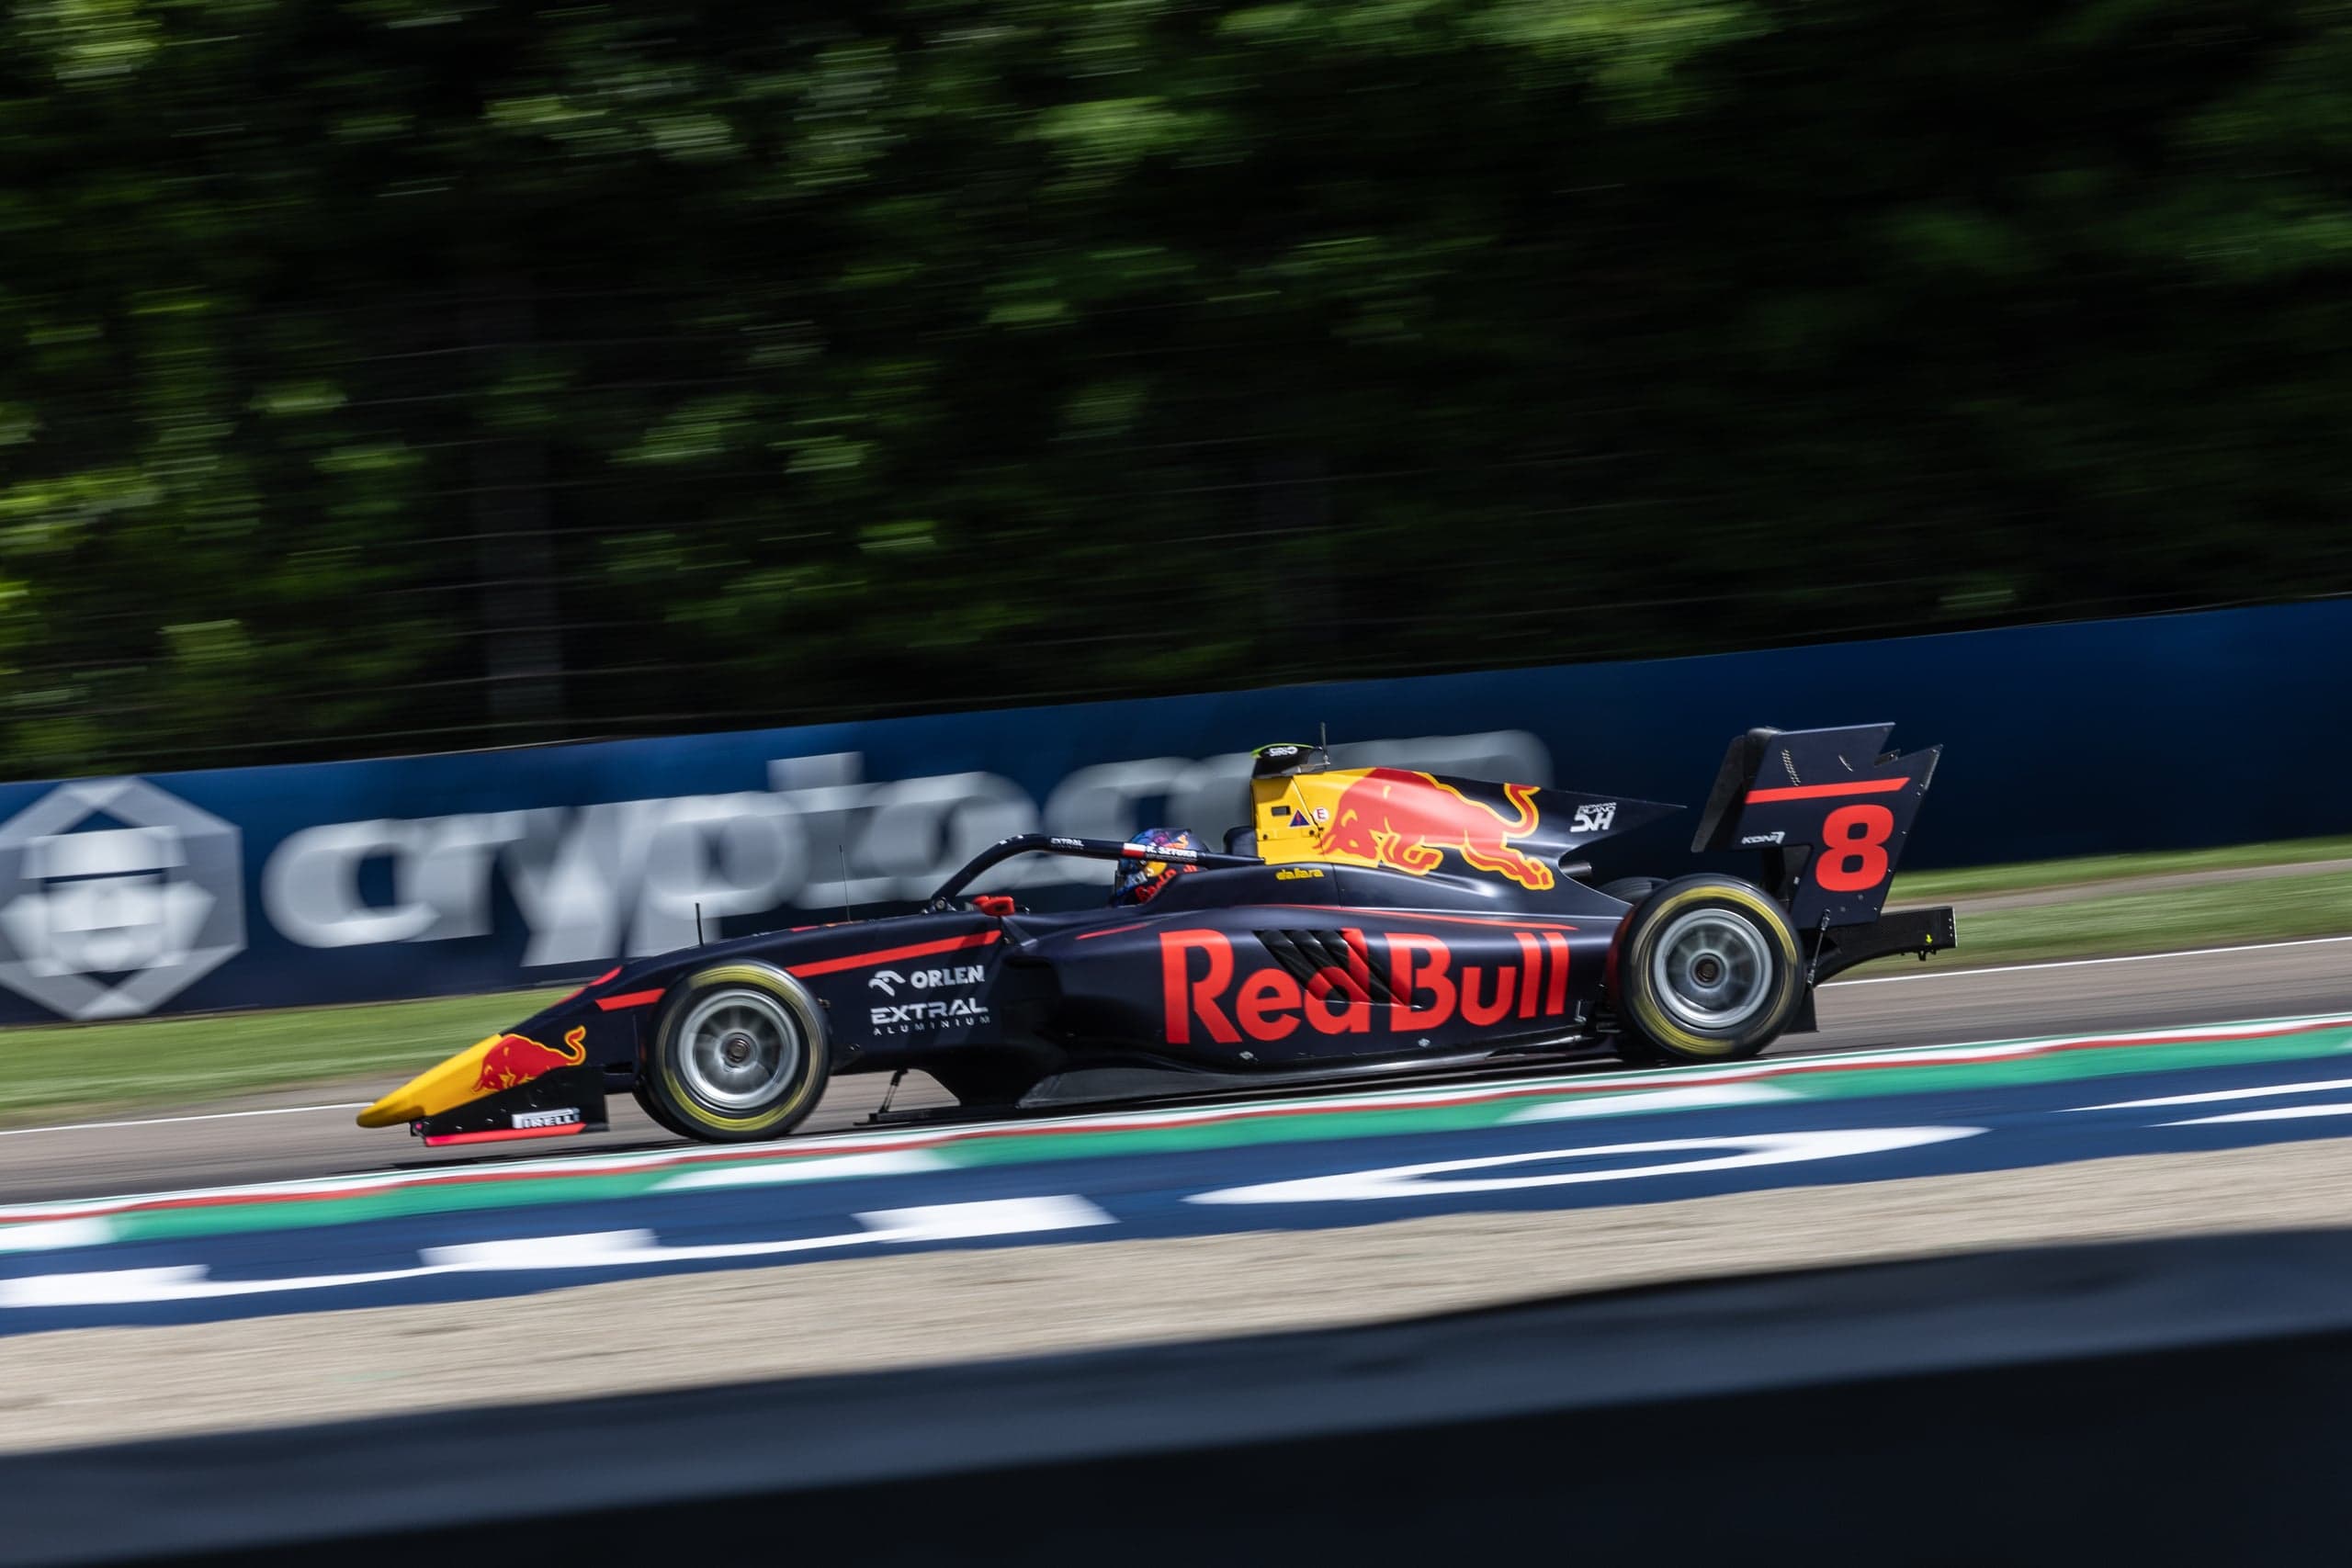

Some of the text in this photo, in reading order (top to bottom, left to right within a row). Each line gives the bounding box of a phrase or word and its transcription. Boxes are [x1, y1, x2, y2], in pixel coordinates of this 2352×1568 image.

[1815, 804, 1894, 892] 8
[910, 964, 986, 989] ORLEN
[1159, 927, 1570, 1044] Red Bull
[870, 997, 989, 1025] EXTRAL
[873, 1015, 991, 1036] ALUMINIUM
[512, 1107, 581, 1129] PIRELLI
